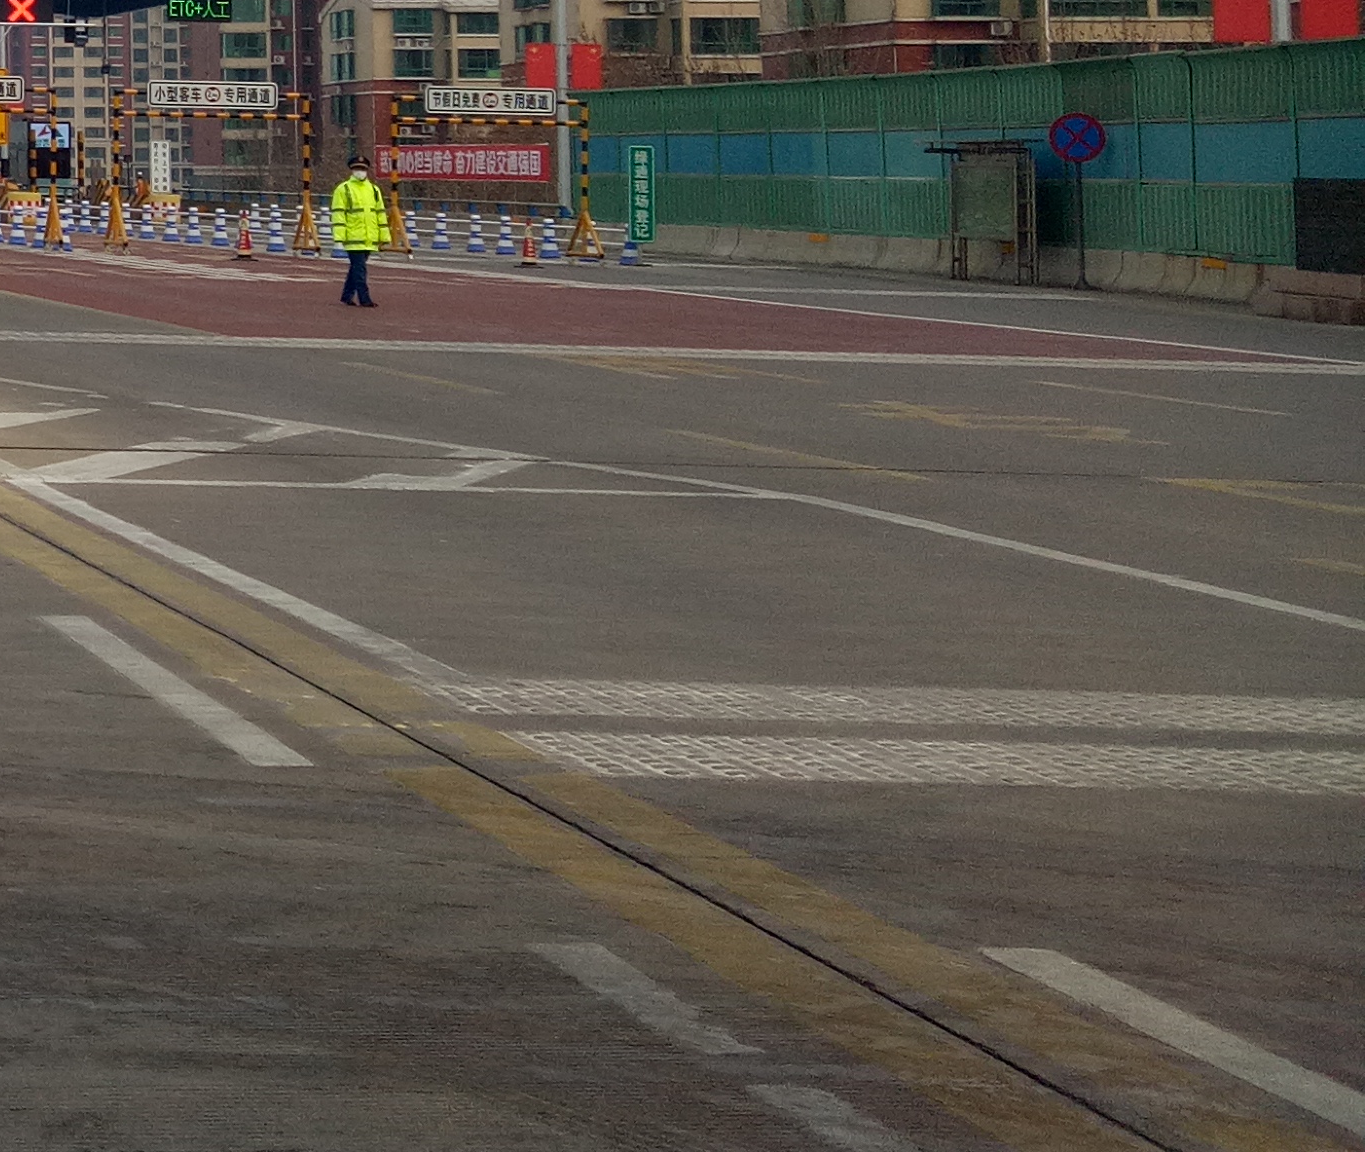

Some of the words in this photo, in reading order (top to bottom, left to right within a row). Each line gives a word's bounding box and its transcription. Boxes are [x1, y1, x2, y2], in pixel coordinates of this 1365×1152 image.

[168, 0, 231, 18] ETC+人工
[154, 86, 201, 103] 小型客车
[224, 87, 271, 103] 专用通道
[432, 91, 480, 109] 节假日免费
[502, 93, 549, 110] 专用通道
